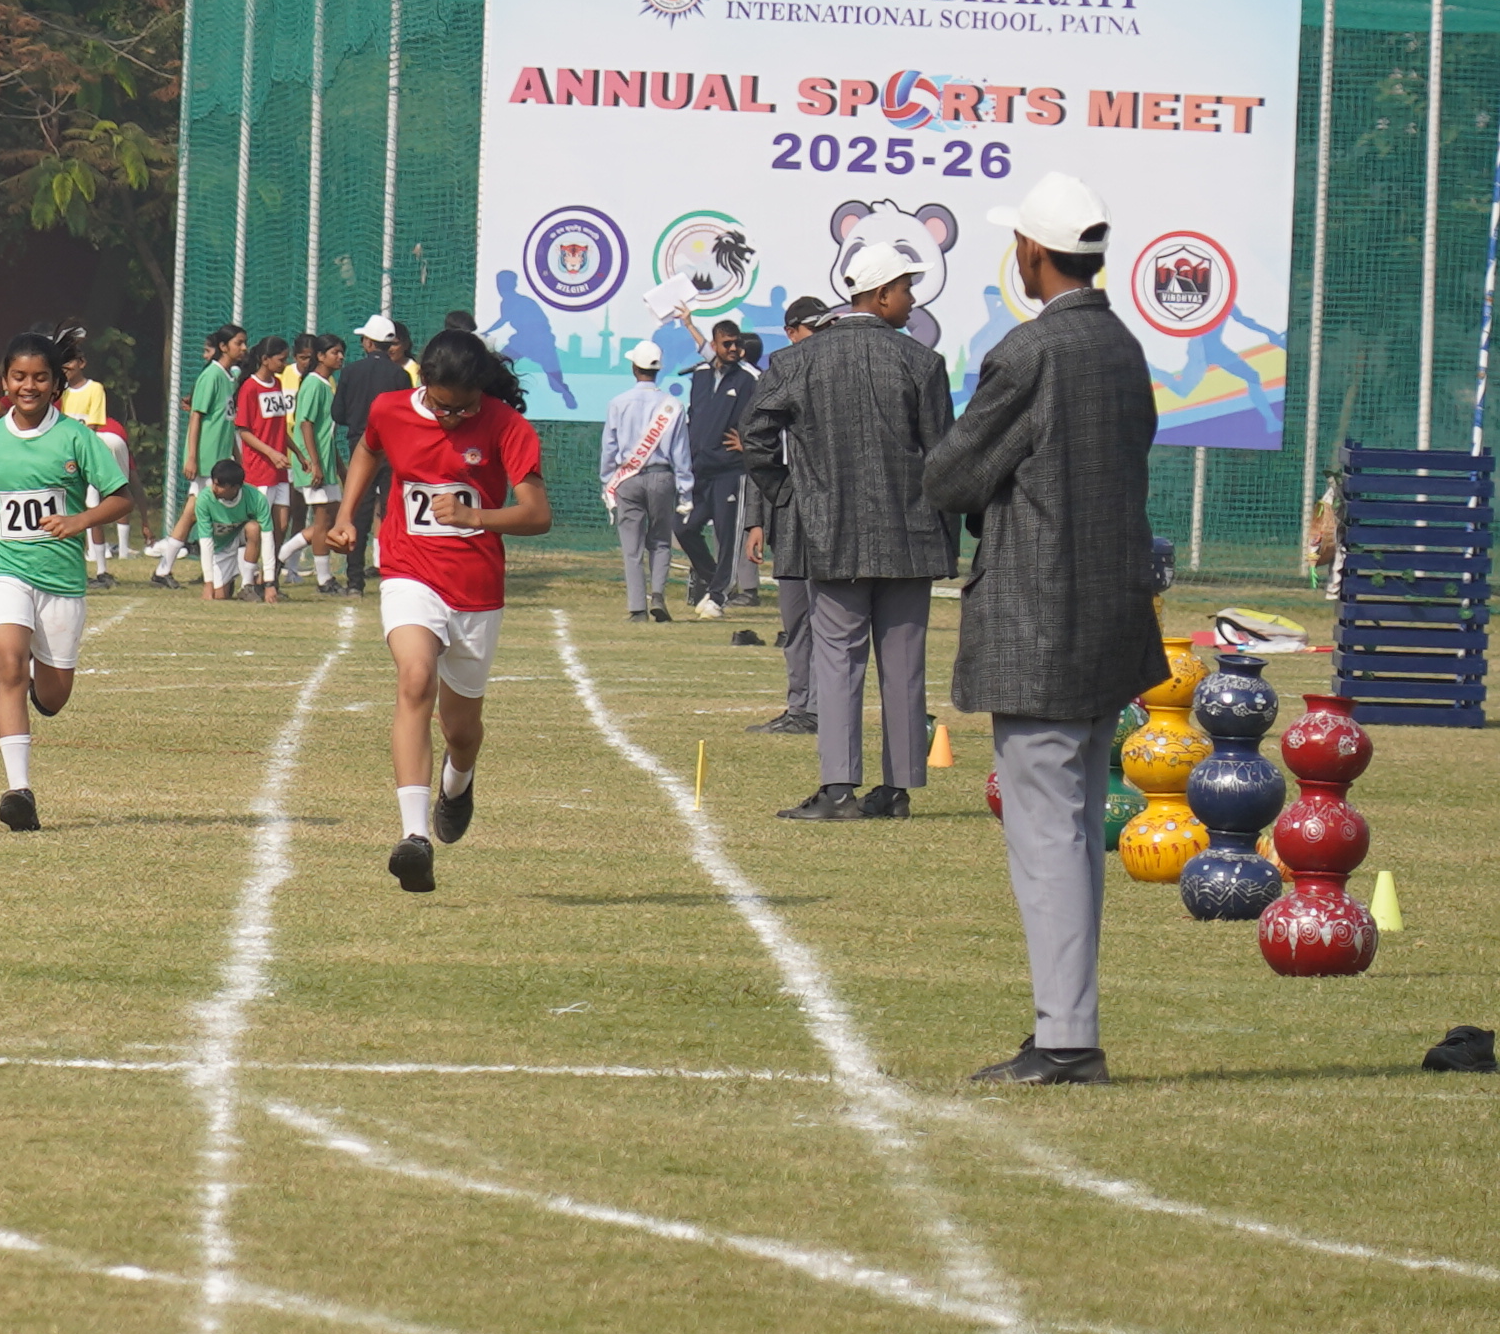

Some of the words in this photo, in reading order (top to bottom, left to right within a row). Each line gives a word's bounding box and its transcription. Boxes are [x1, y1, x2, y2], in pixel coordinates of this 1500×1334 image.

[726, 0, 932, 27] INTERNATIONAL
[939, 9, 1053, 35] SCHOOL,
[1060, 14, 1141, 36] PATNA
[509, 67, 776, 113] ANNUAL
[1087, 89, 1265, 134] MEET
[771, 132, 1012, 179] 2025-26
[5, 496, 58, 532] 201
